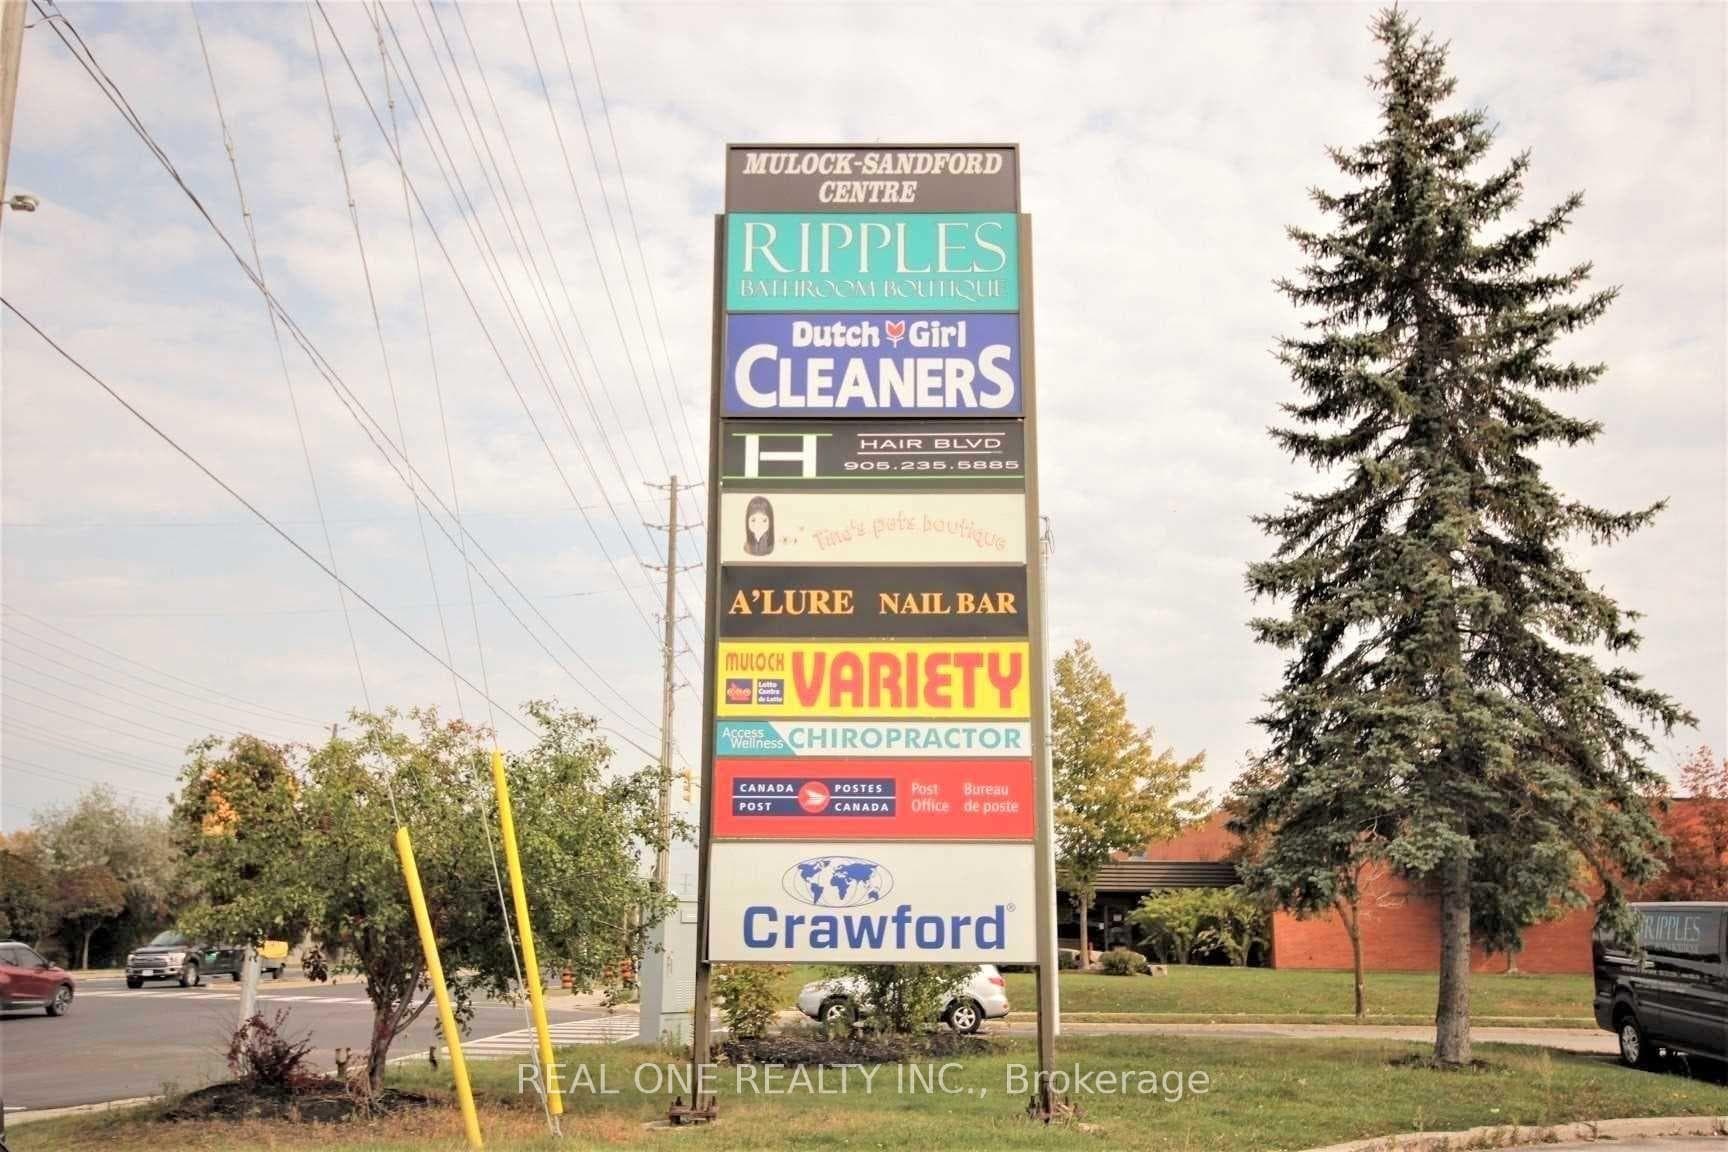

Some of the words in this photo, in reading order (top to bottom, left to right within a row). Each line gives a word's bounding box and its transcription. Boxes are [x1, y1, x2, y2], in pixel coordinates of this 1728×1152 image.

[742, 152, 1002, 175] MULOCK-SANDFORD
[818, 180, 917, 203] CENTRE
[743, 222, 1007, 273] RIPPLES
[741, 279, 876, 298] BATHROOM
[884, 279, 1005, 301] BOUTIQUE
[792, 321, 880, 348] Dutch
[908, 321, 966, 348] Girl
[734, 344, 1015, 409] CLEANERS
[860, 438, 923, 450] HAIR
[934, 437, 1002, 449] BLVD
[843, 460, 1020, 471] 905.235.5885
[728, 589, 854, 615] A'LURE
[879, 592, 950, 615] NAIL
[956, 593, 1018, 615] BAR
[791, 651, 1023, 708] VARIETY
[722, 727, 765, 738] Access
[788, 727, 1022, 749] CHIROPRACTOR
[730, 737, 785, 750] Wellness
[740, 783, 794, 793] CANADA
[835, 784, 883, 793] POSTES
[911, 783, 939, 795] Post
[964, 783, 1010, 796] Bureau
[740, 802, 772, 811] POST
[835, 802, 889, 812] CANADA
[911, 800, 949, 813] Office
[964, 800, 979, 812] de
[983, 800, 1019, 815] poste
[743, 904, 1006, 950] Crawford
[1643, 914, 1702, 941] RIPPLES
